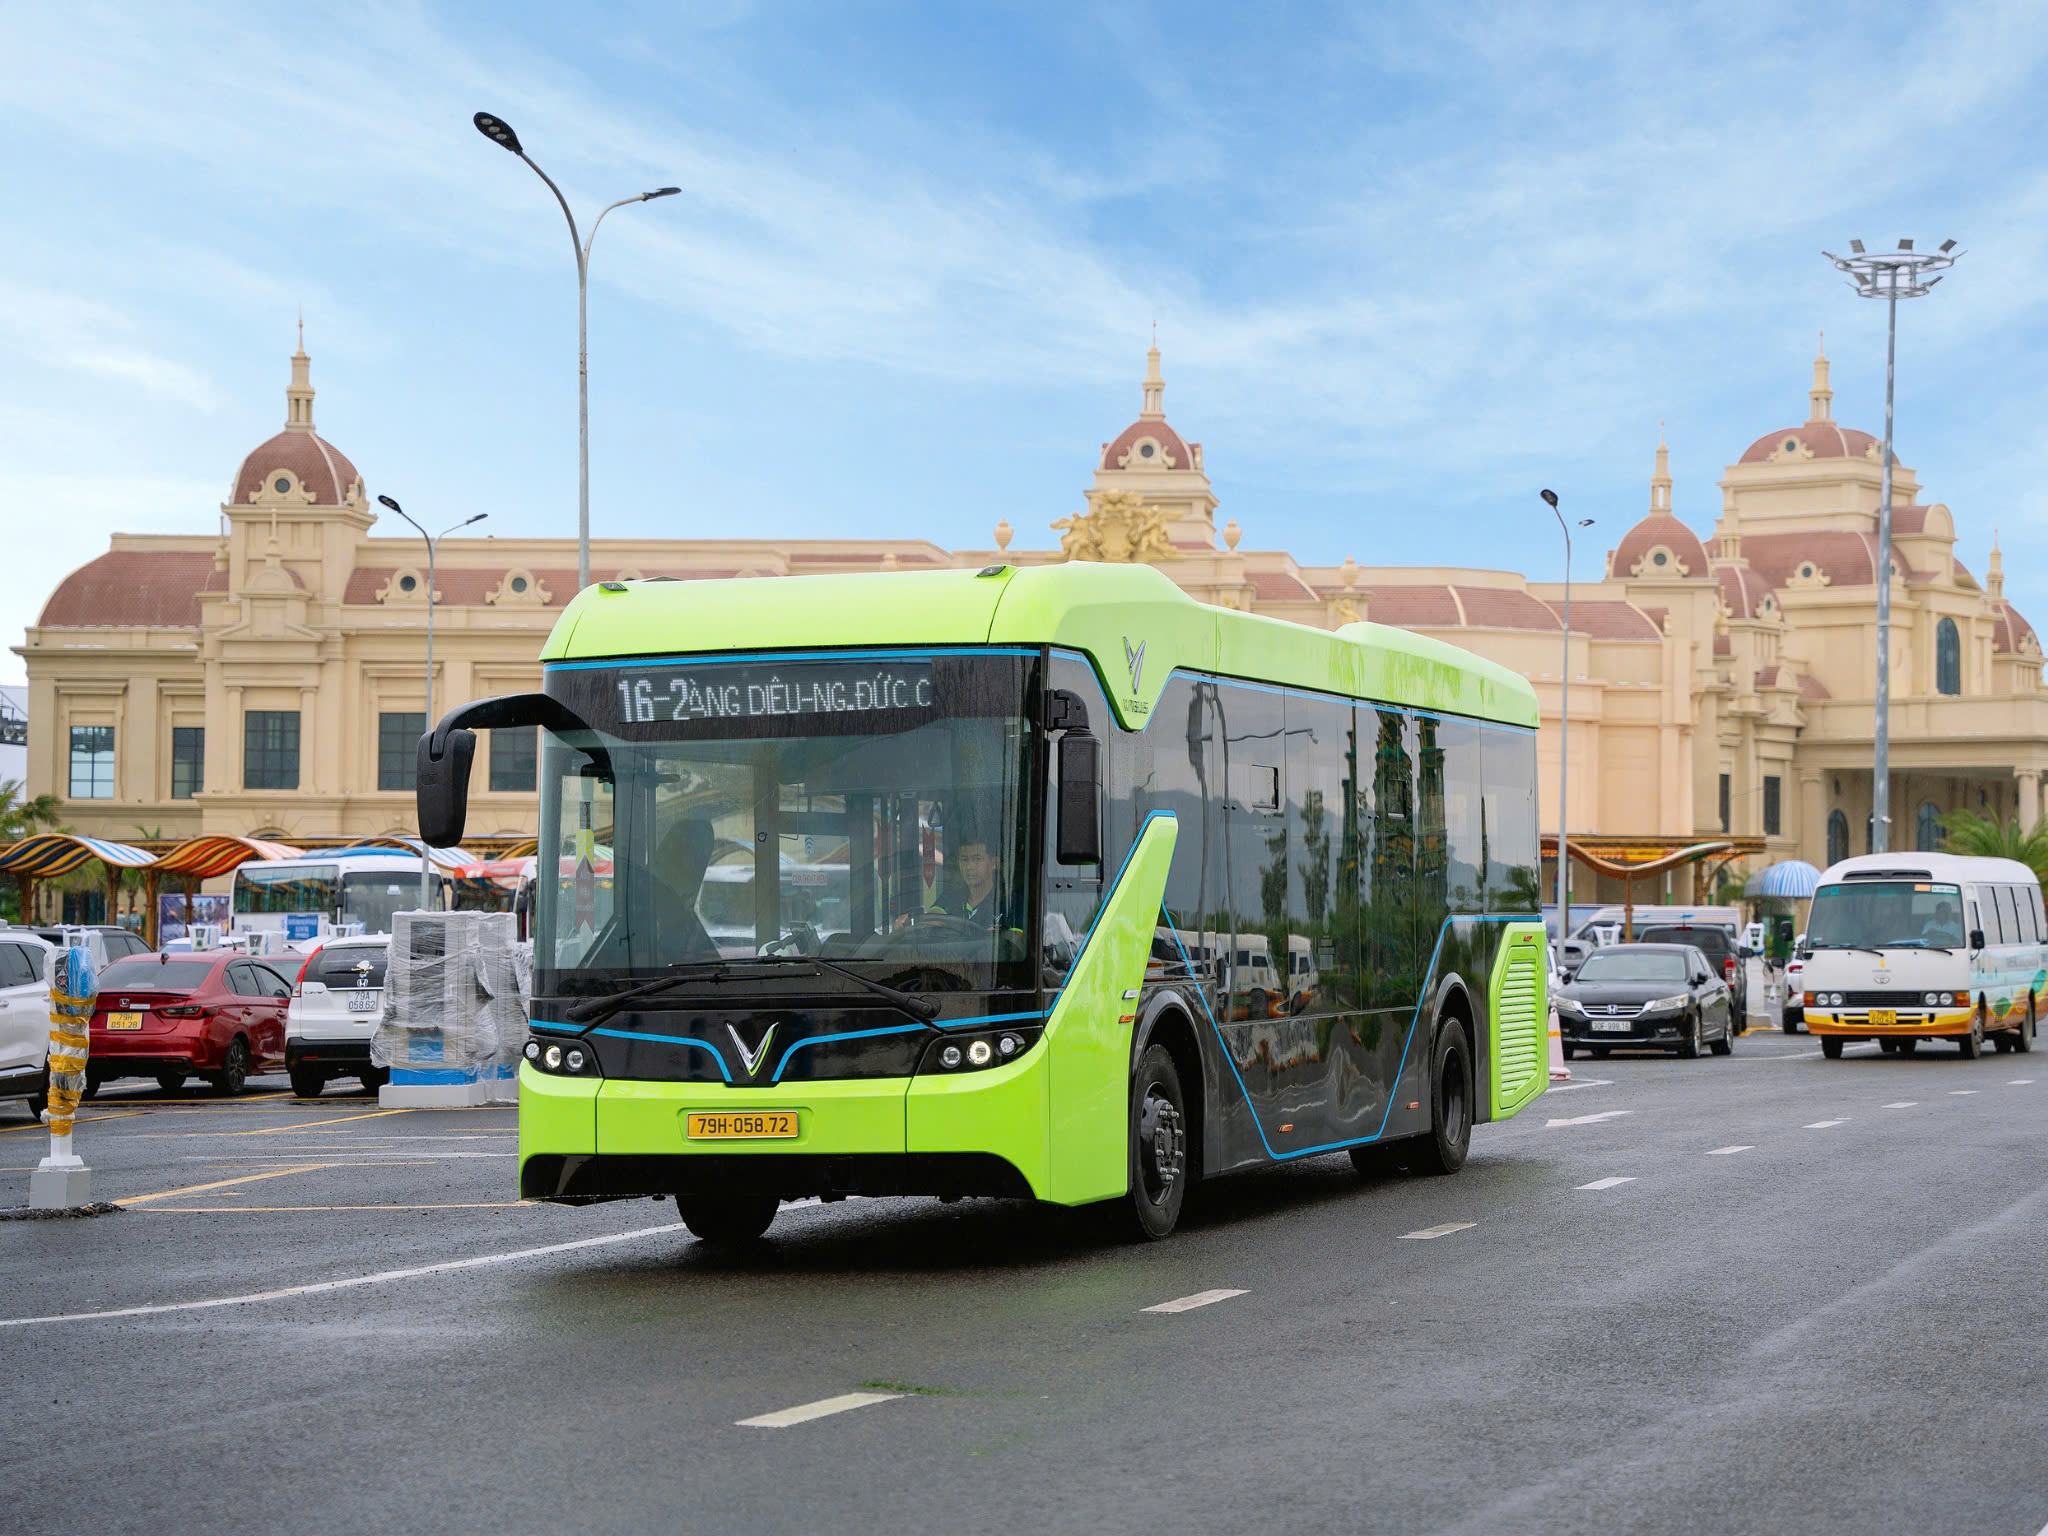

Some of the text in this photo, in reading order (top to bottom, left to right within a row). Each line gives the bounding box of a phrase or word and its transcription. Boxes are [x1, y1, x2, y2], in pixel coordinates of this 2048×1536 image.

[355, 991, 370, 1001] 79A
[348, 1000, 376, 1010] 058.62
[119, 1013, 133, 1021] 79H
[697, 1117, 788, 1134] 79H-058.72
